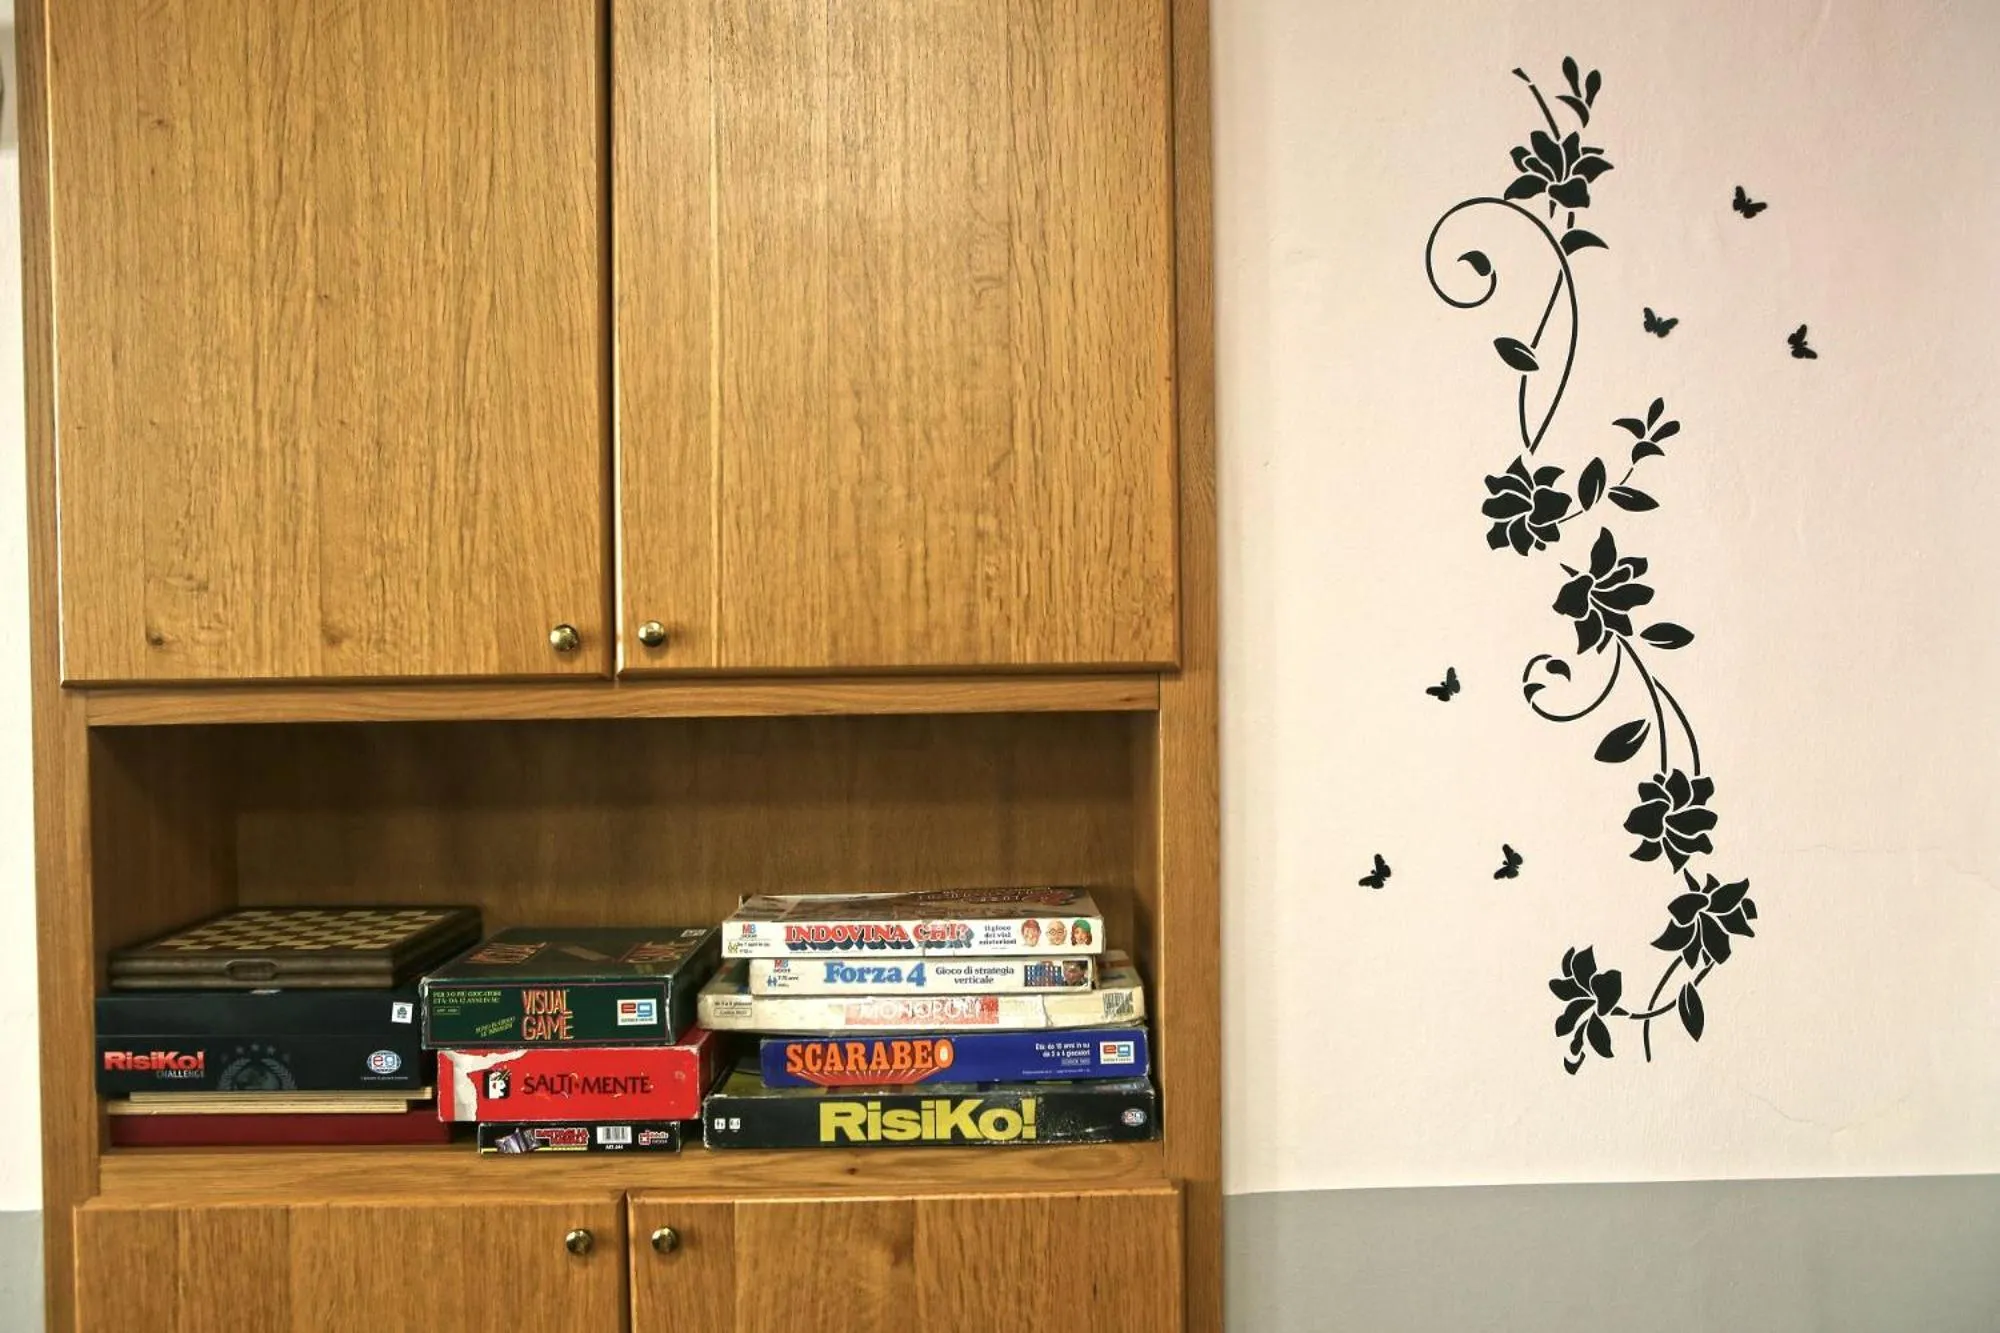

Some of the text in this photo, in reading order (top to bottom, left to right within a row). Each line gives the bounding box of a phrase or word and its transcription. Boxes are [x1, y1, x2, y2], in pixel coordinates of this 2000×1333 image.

[784, 924, 911, 946] INDOVINA
[823, 962, 926, 986] Forza 4
[935, 965, 1015, 977] Gioco di strategia
[954, 975, 994, 985] verticale
[522, 989, 573, 1015] VISUAL
[523, 1013, 575, 1041] GAME
[103, 1050, 205, 1071] RisiKo!
[786, 1038, 954, 1073] SCARABEO
[819, 1098, 1037, 1142] RisiKo!
